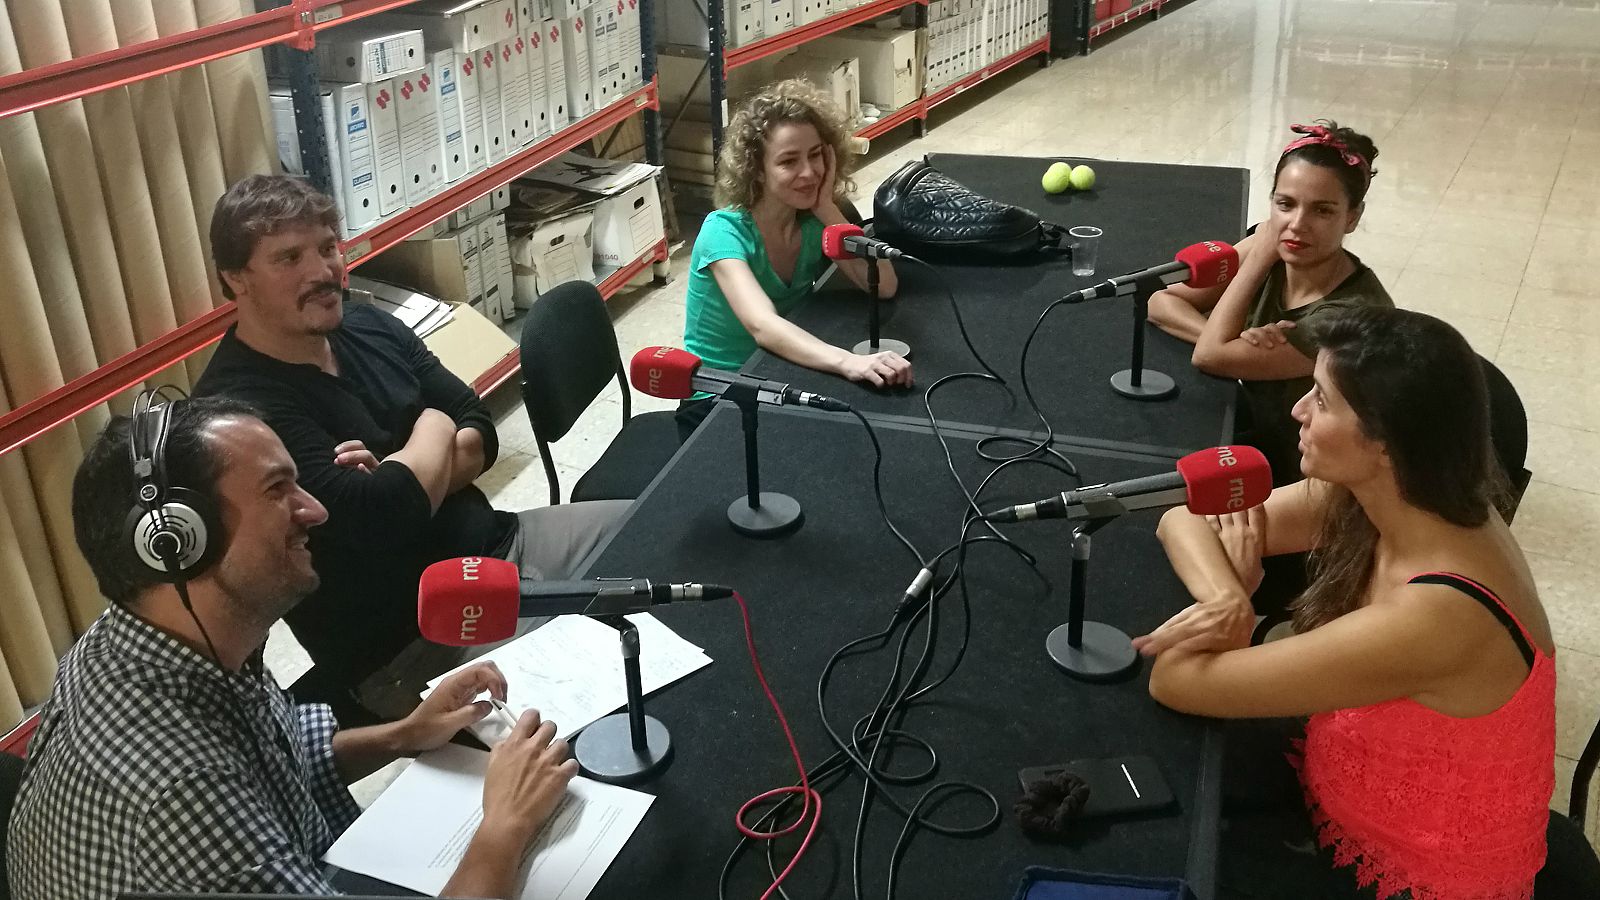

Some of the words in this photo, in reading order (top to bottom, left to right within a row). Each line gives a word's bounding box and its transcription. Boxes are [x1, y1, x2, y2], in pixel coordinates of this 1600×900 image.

[1217, 258, 1229, 284] rne
[648, 368, 662, 394] rne
[1226, 478, 1245, 510] rne
[461, 556, 482, 581] rne
[460, 605, 484, 641] rne
